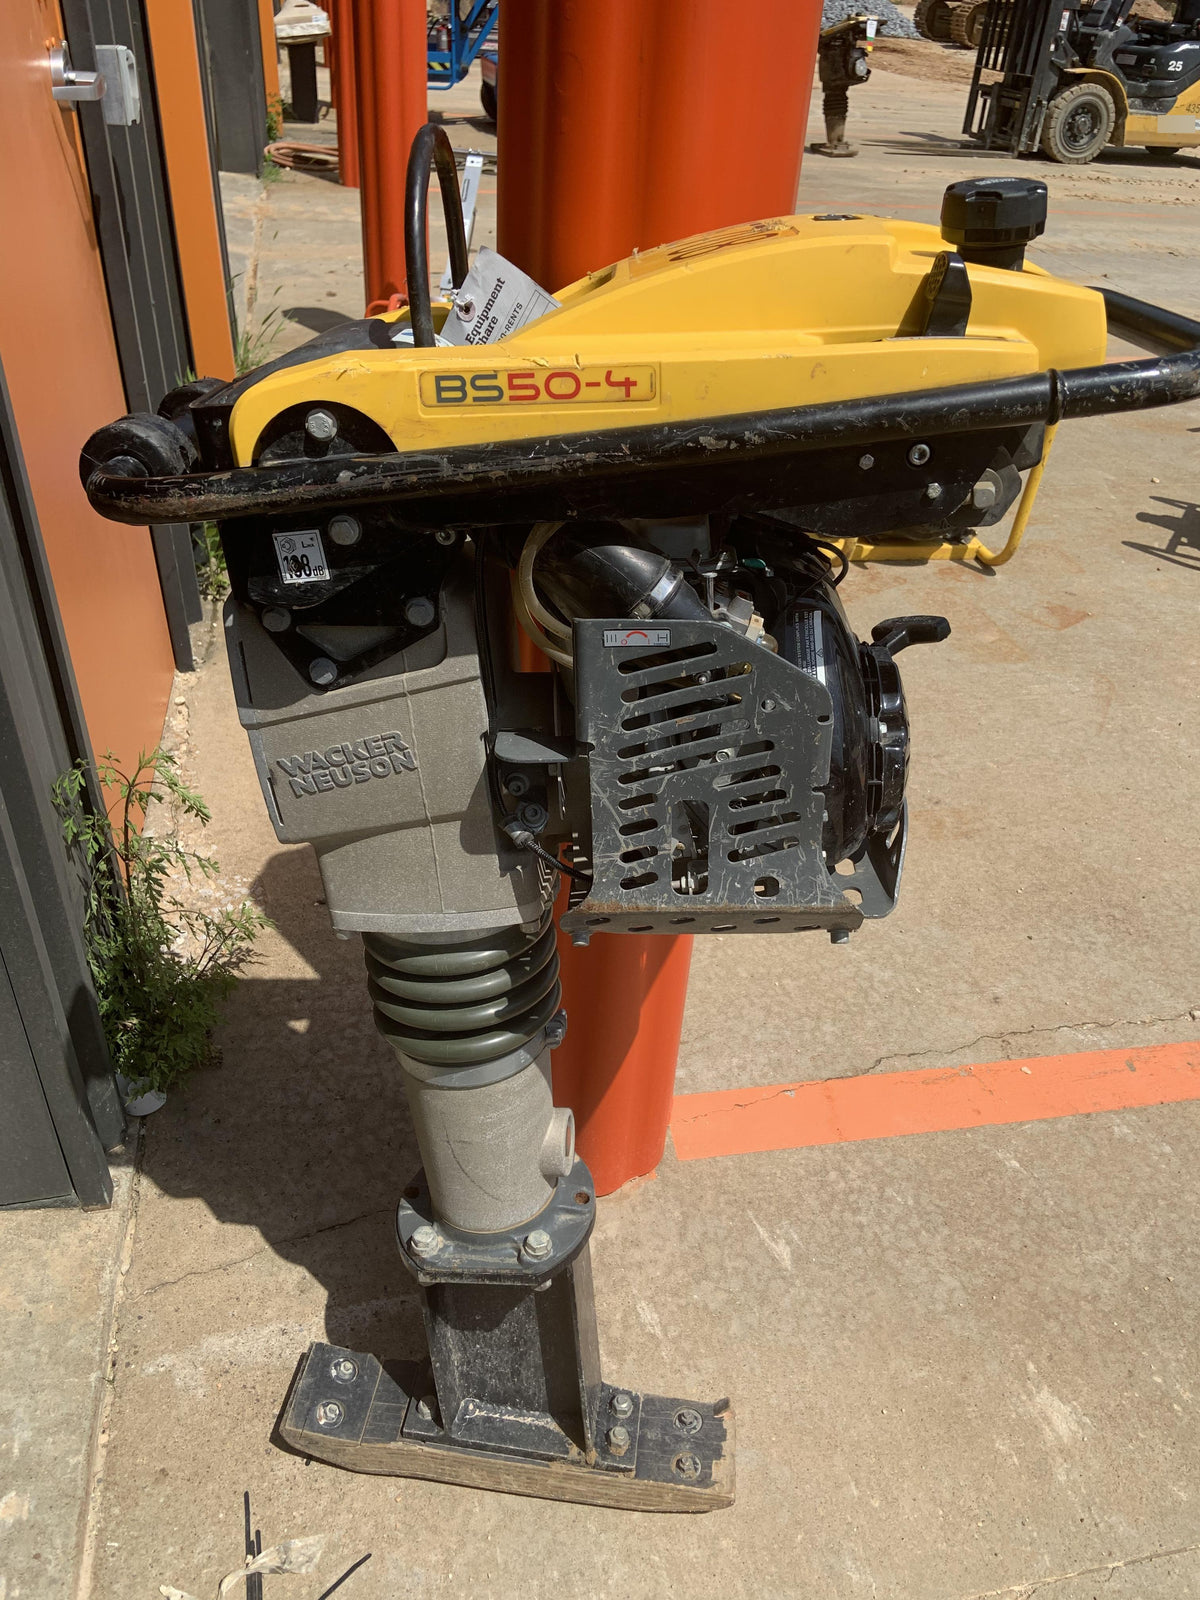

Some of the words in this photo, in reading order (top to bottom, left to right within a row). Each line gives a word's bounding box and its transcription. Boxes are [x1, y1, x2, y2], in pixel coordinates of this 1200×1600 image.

[1168, 61, 1183, 71] 25
[465, 277, 506, 345] Equipment
[434, 369, 638, 403] BS50-4
[276, 731, 409, 777] WACKER
[289, 750, 418, 799] NEUSON
